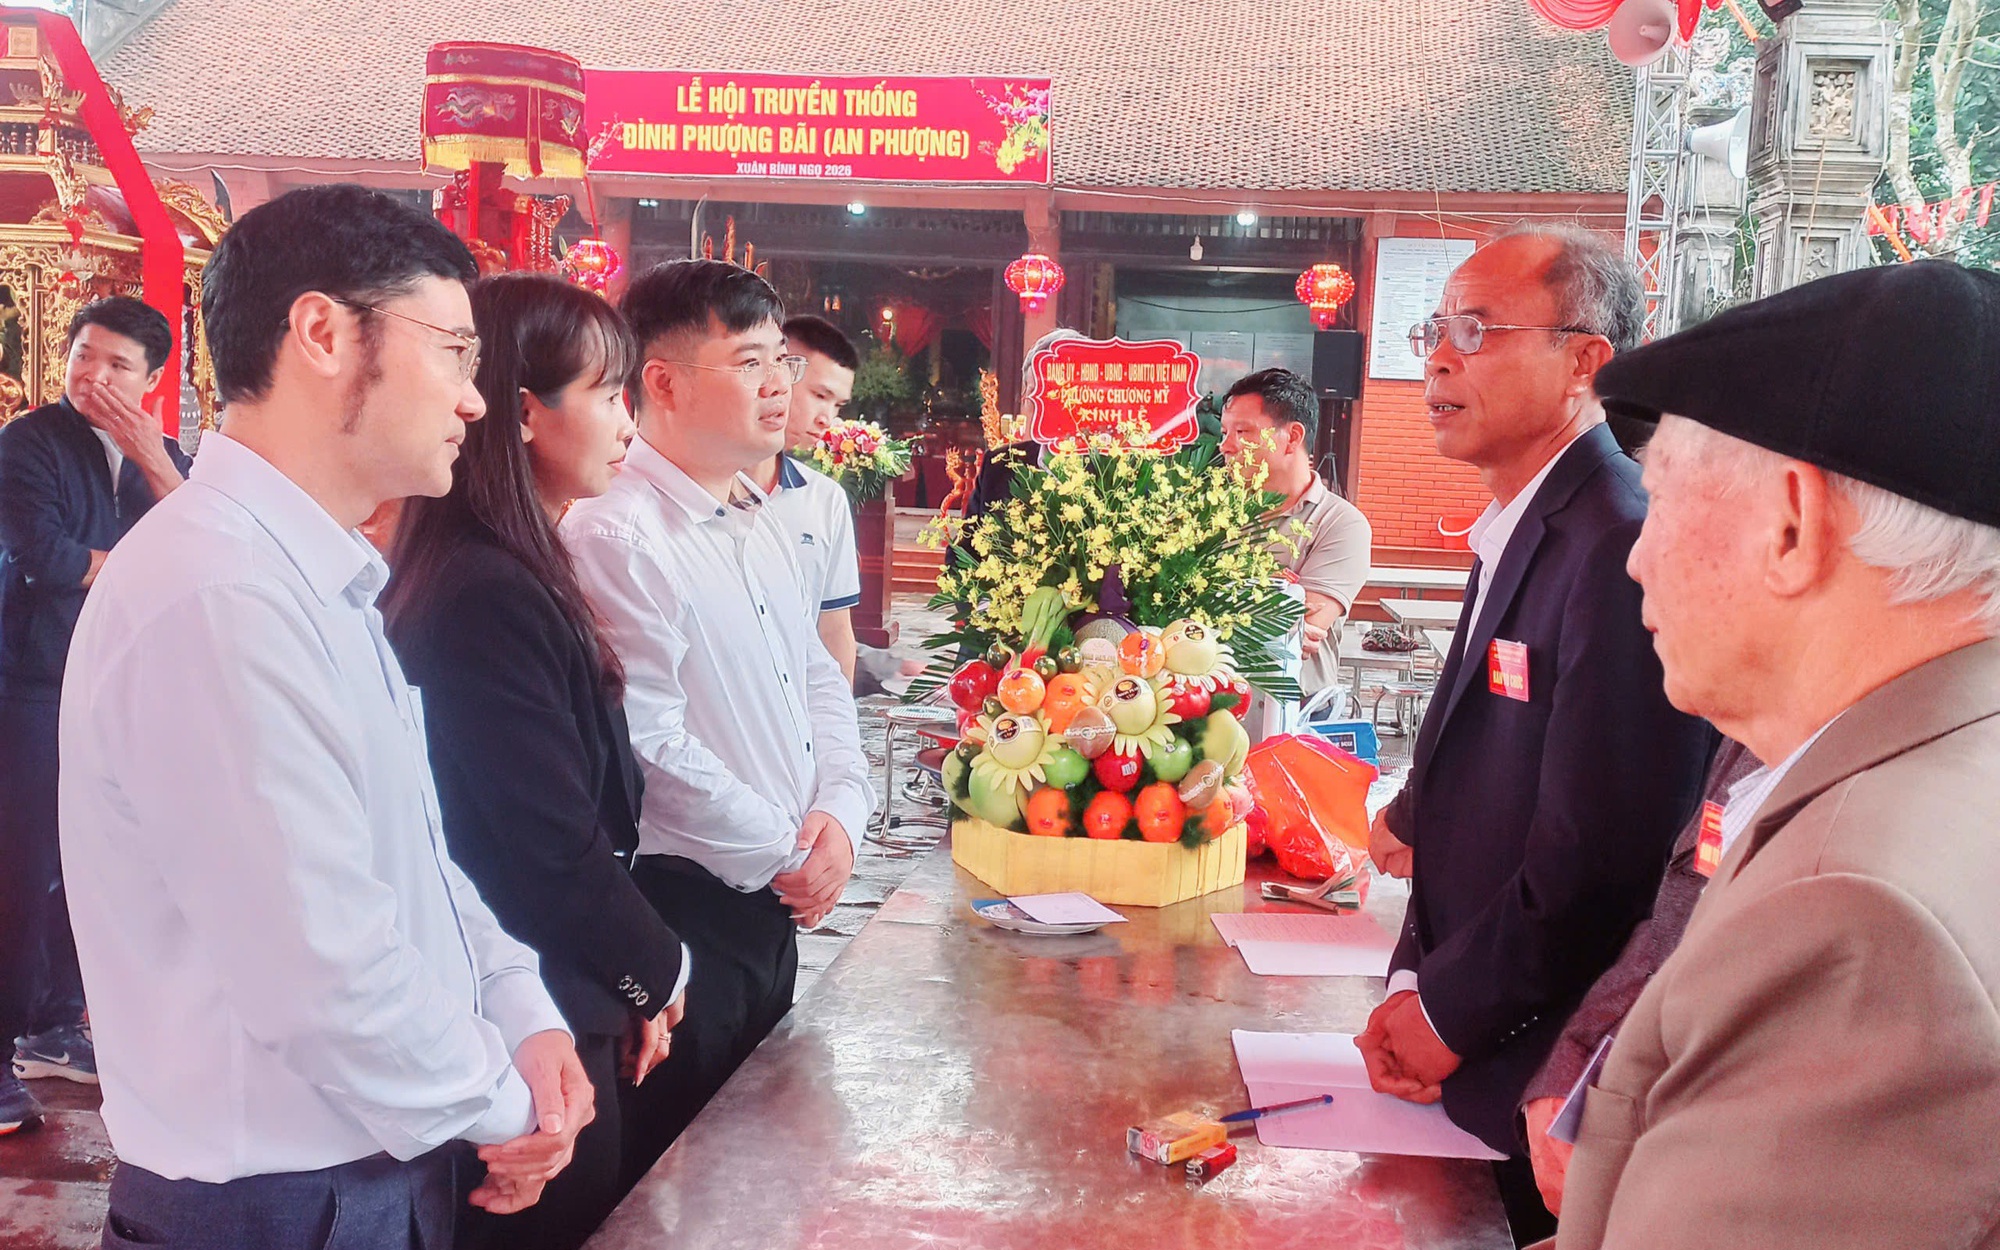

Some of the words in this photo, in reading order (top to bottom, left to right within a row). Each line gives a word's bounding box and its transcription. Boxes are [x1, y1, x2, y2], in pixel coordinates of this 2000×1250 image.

[677, 76, 702, 113] LỄ
[708, 81, 746, 119] HỘI
[752, 80, 837, 116] TRUYỀN
[843, 80, 917, 117] THỐNG
[623, 118, 676, 151] ĐÌNH
[682, 123, 772, 158] PHƯỢNG
[779, 122, 817, 154] BÃI
[824, 127, 863, 158] (AN
[869, 126, 970, 162] PHƯỢNG)
[736, 160, 767, 175] XUÂN
[769, 161, 797, 175] BÍNH
[799, 164, 822, 178] NGỌ
[825, 164, 852, 176] 2026
[1107, 386, 1151, 404] CHƯƠNG
[1153, 384, 1170, 404] MỸ
